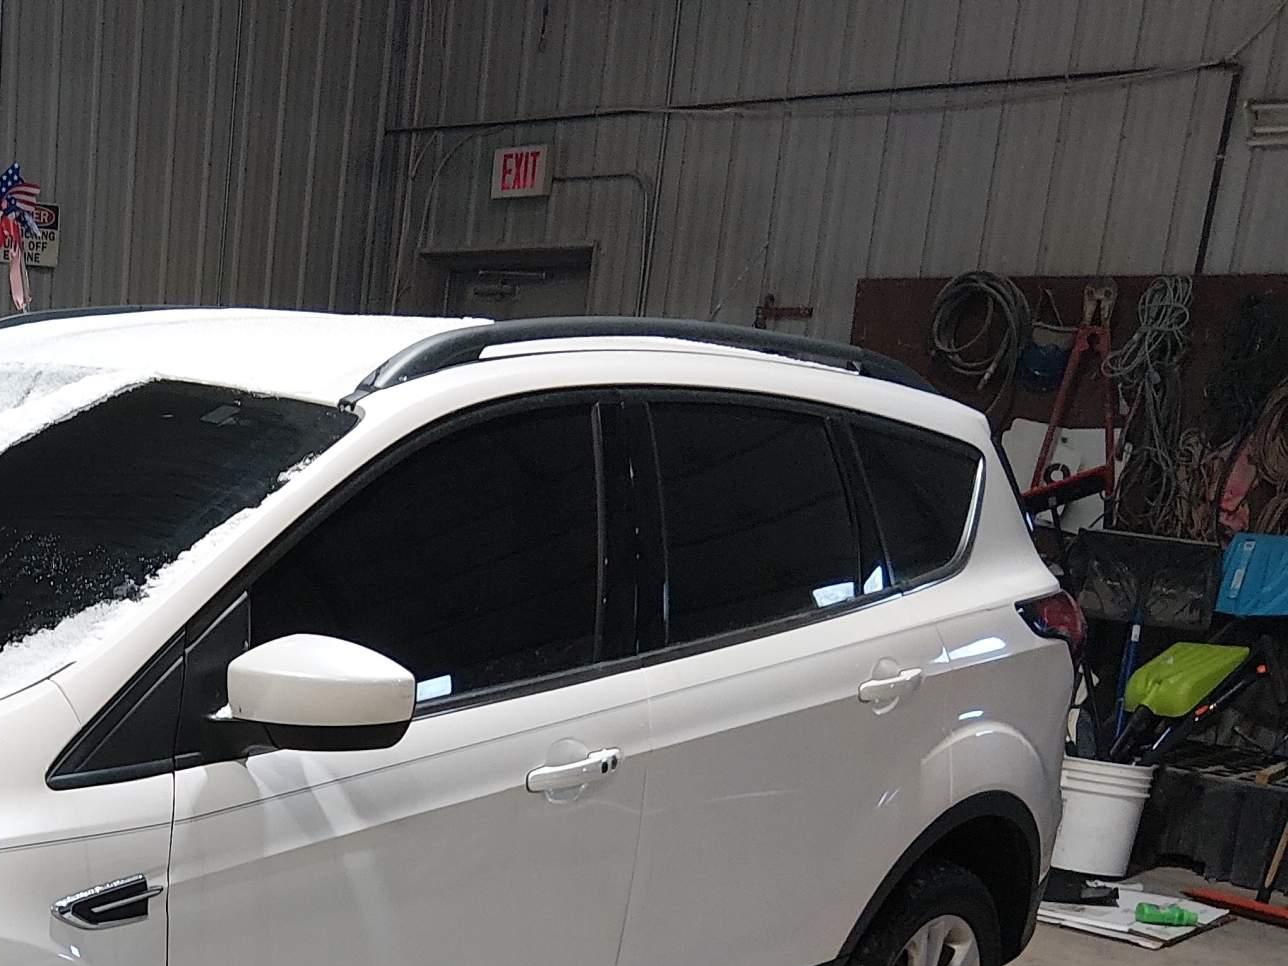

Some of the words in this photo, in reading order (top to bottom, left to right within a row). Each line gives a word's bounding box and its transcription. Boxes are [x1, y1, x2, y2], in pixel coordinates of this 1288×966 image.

[501, 151, 540, 191] EXIT
[28, 240, 48, 252] OFF
[3, 249, 41, 263] EINE
